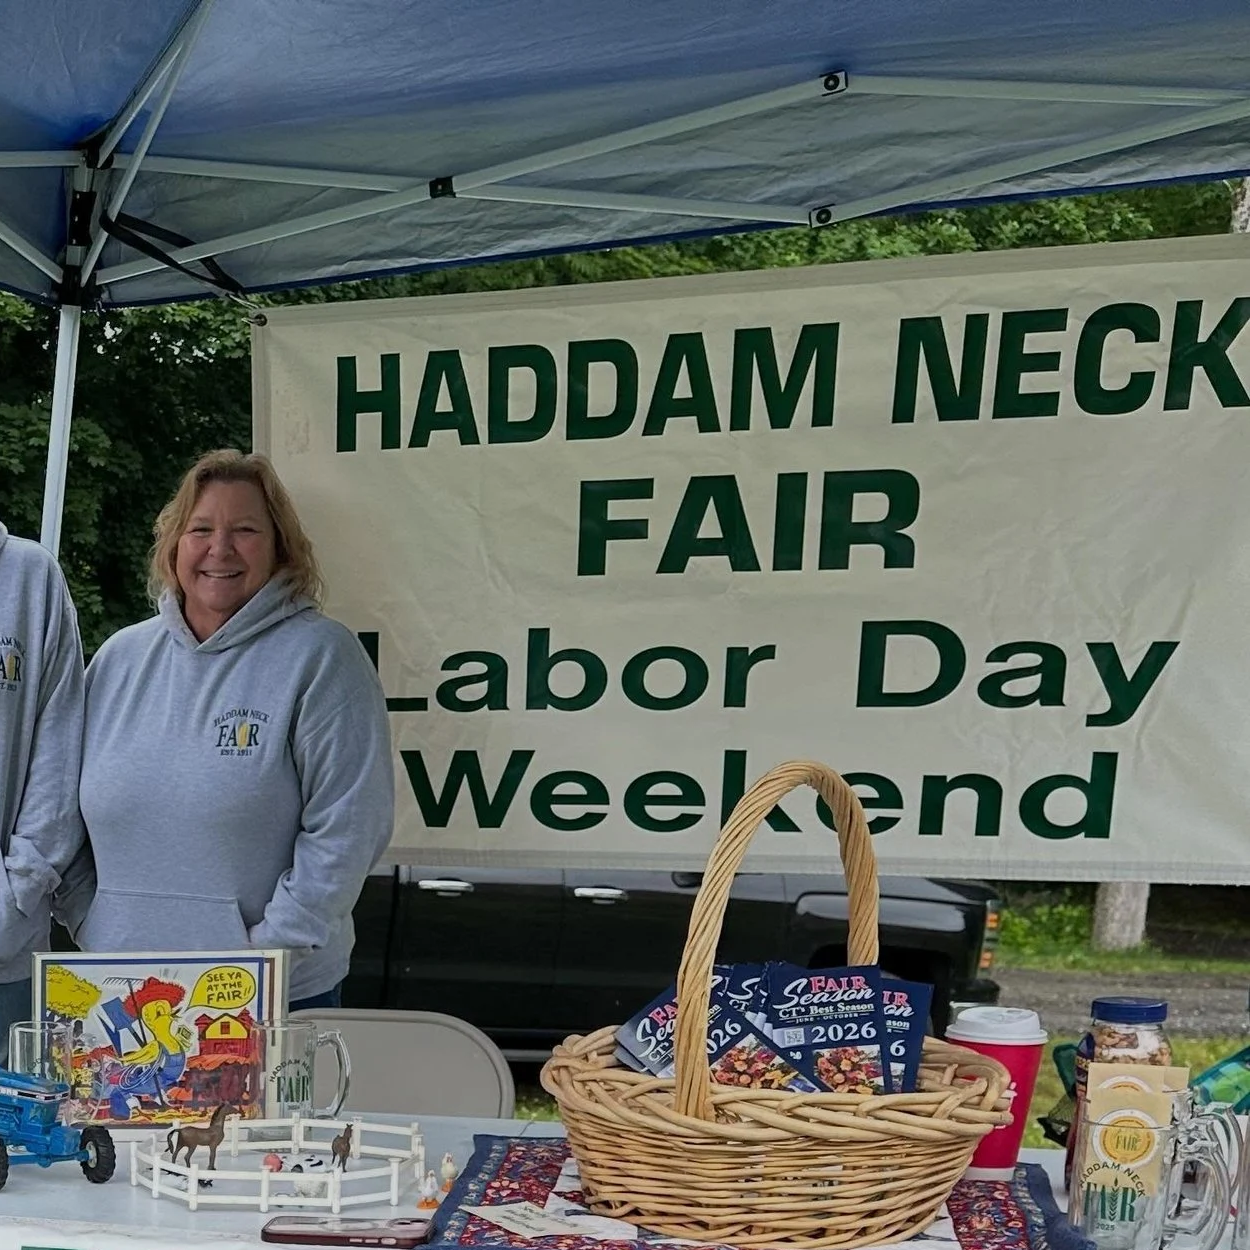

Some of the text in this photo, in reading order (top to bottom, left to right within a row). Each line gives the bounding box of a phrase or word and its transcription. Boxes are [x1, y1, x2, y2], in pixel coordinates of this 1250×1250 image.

[337, 298, 1250, 451] HADDAM NECK
[578, 469, 919, 576] FAIR
[856, 620, 1180, 727] Day
[214, 709, 270, 728] HADDAM NECK
[399, 749, 1118, 839] Weekend
[206, 971, 242, 982] SEE YA
[206, 981, 242, 992] AT THE
[810, 976, 869, 993] FAIR
[773, 977, 876, 1009] Season
[809, 1004, 835, 1015] Best
[837, 1002, 875, 1012] Season
[706, 1018, 742, 1055] 026
[811, 1021, 877, 1043] 2026
[1079, 1161, 1146, 1197] HADDAM NECK
[1095, 1222, 1115, 1231] 2025
